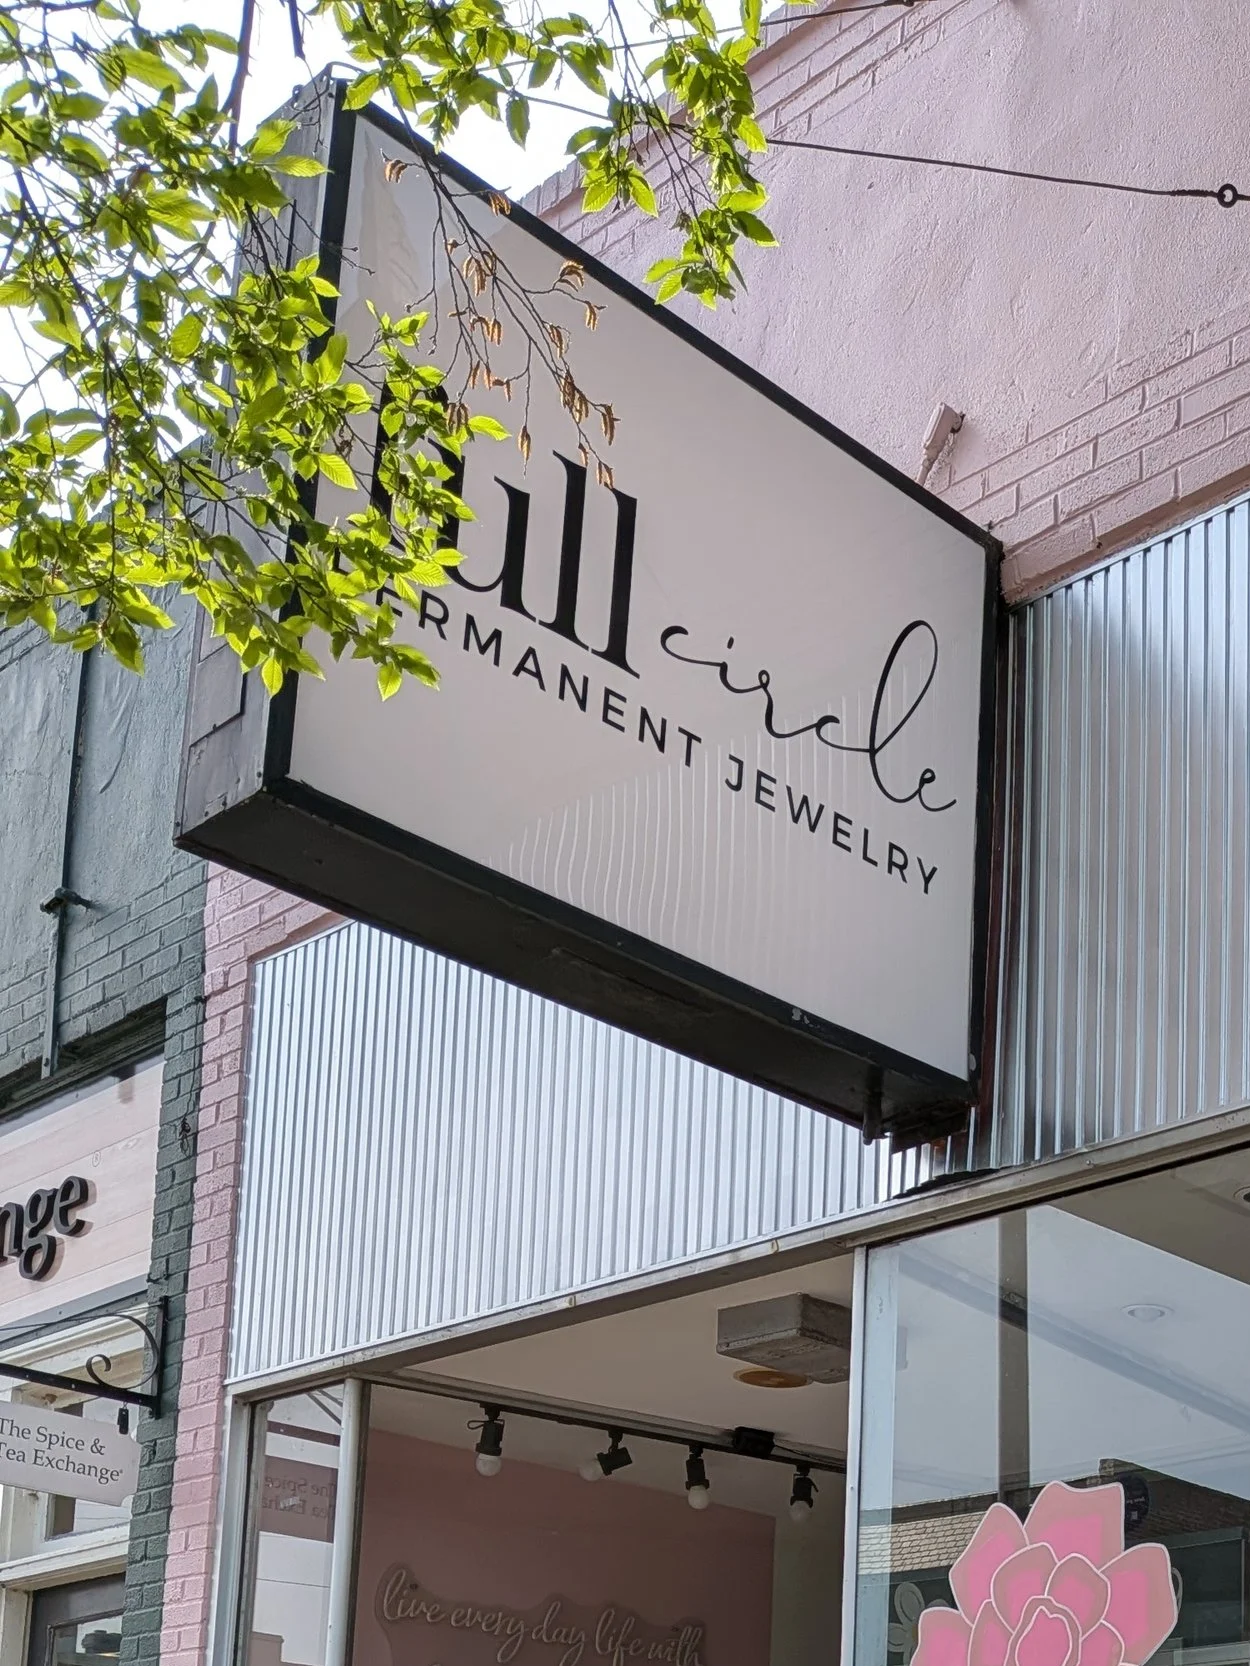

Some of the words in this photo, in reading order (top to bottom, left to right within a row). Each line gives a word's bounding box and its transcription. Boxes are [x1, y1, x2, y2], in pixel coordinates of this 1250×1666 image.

[375, 584, 703, 768] ERMANENT
[724, 755, 939, 895] JEWELRY
[660, 620, 957, 812] circle
[0, 1417, 31, 1440] The
[36, 1426, 85, 1450] Spice
[90, 1438, 106, 1455] &
[384, 1568, 449, 1623] live
